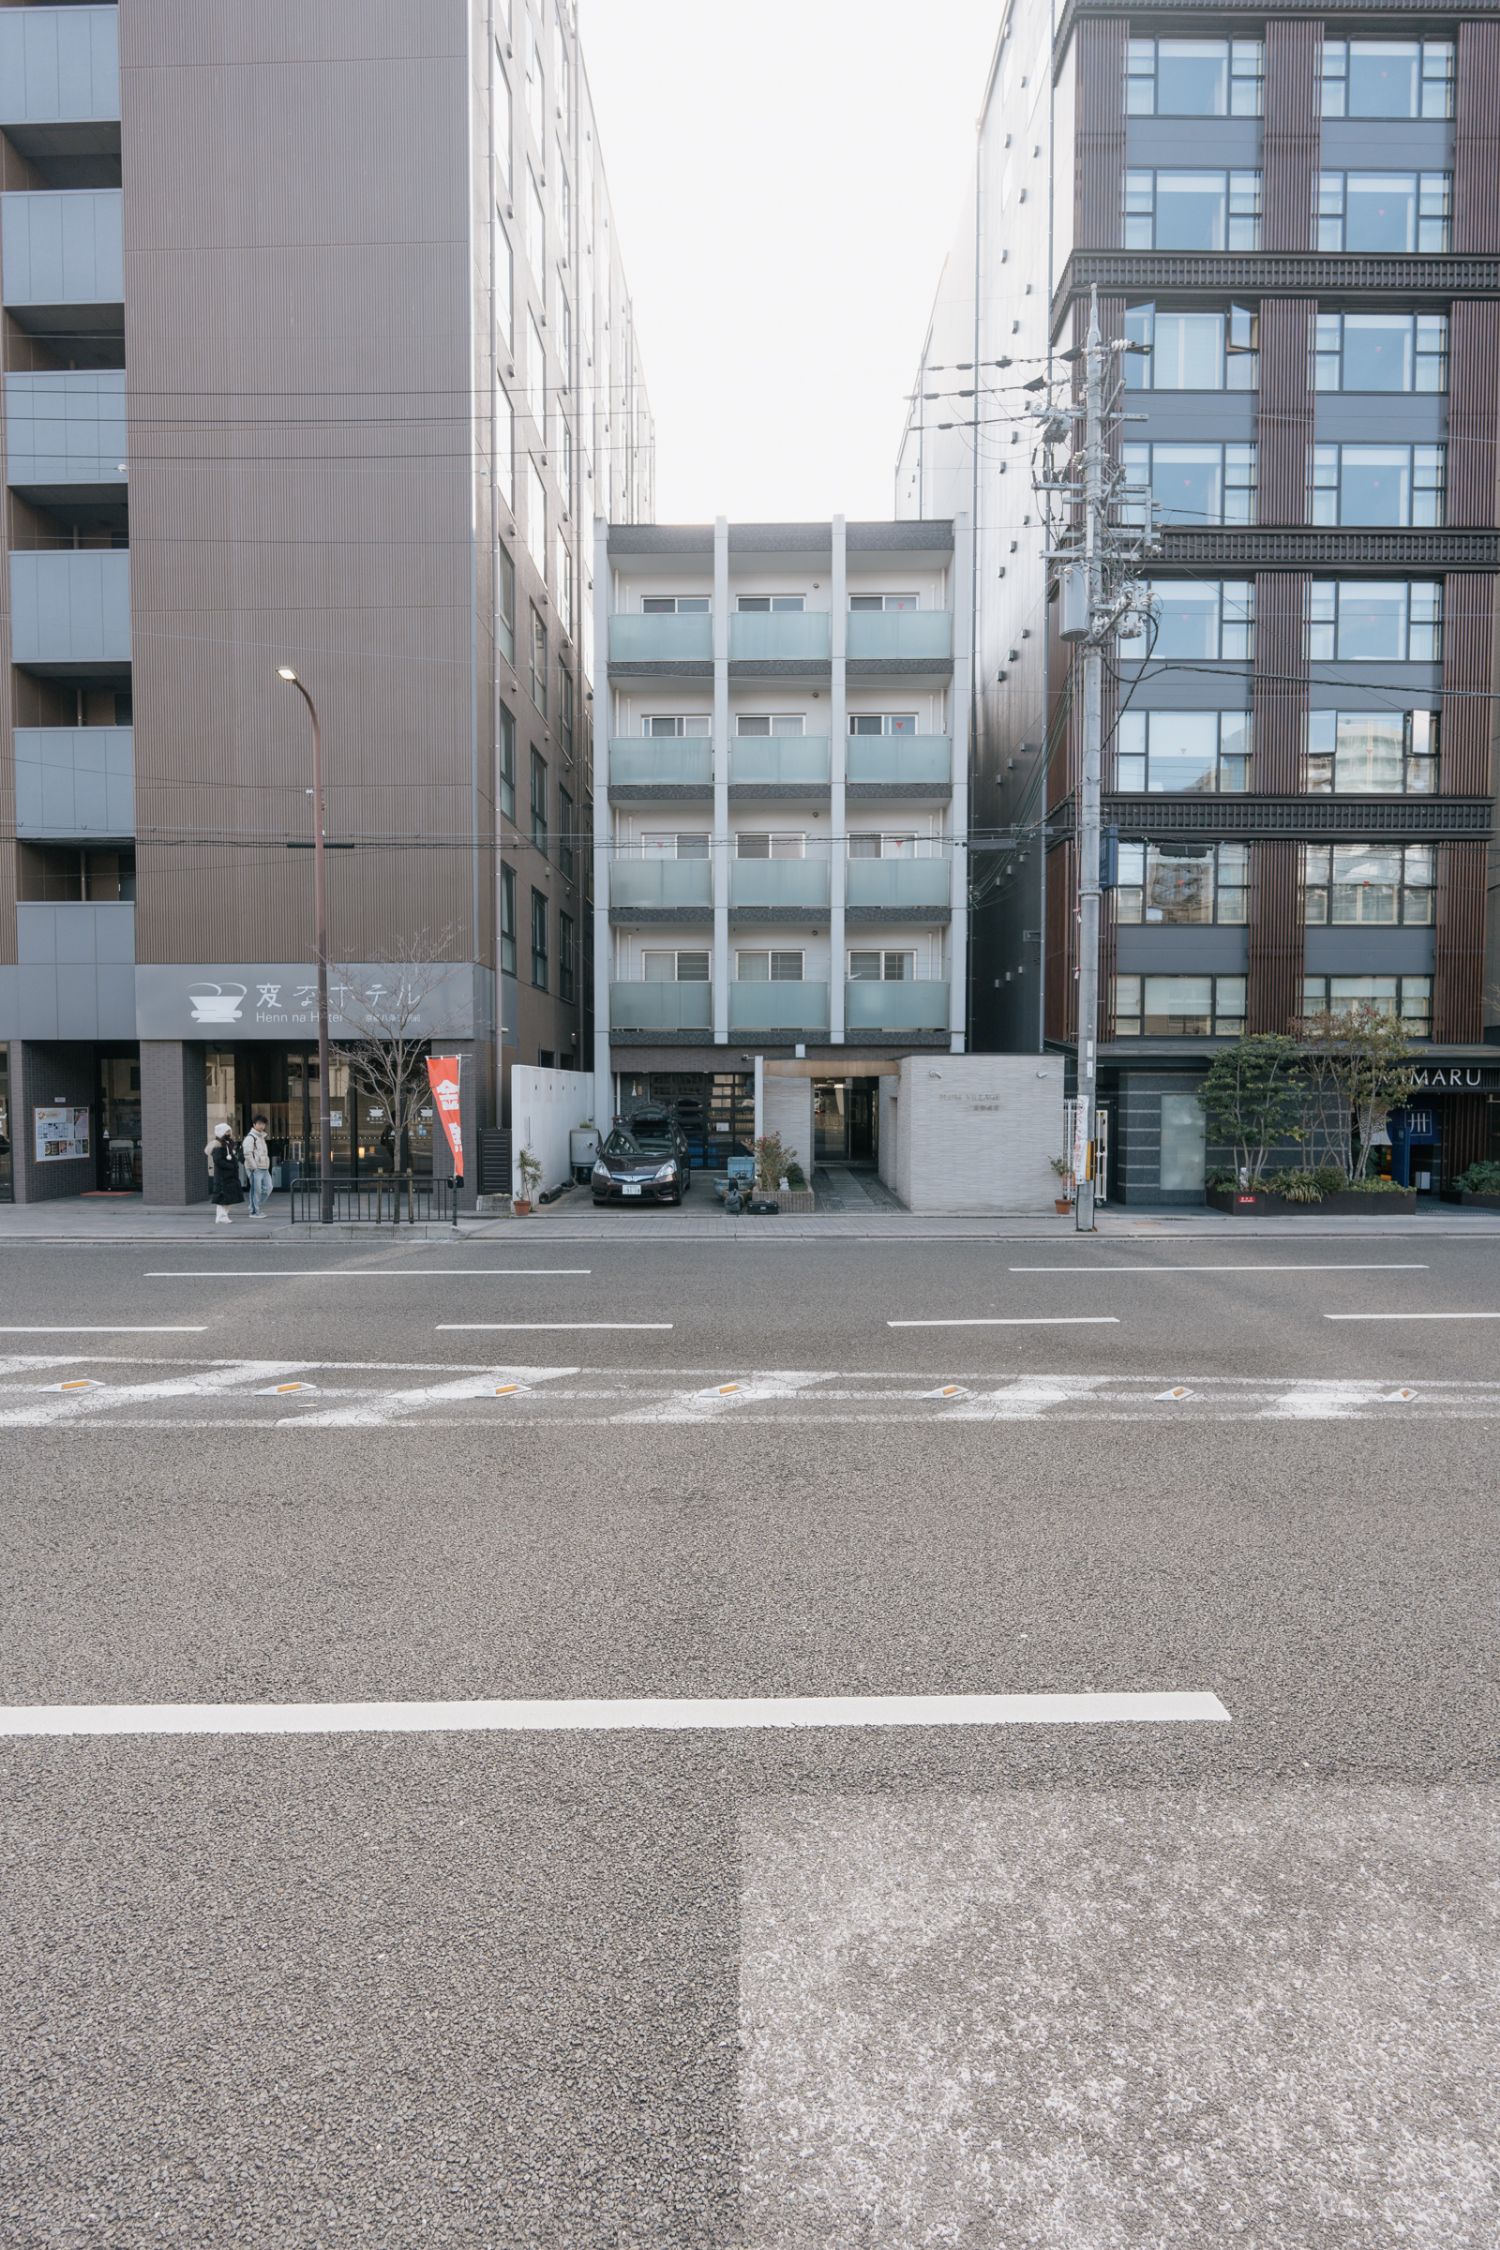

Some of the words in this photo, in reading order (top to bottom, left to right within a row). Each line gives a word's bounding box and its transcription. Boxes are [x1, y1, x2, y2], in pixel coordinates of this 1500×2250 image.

[256, 983, 421, 1008] 変なホテル
[256, 1012, 288, 1023] Henn
[292, 1014, 306, 1023] na
[310, 1012, 343, 1023] Htel
